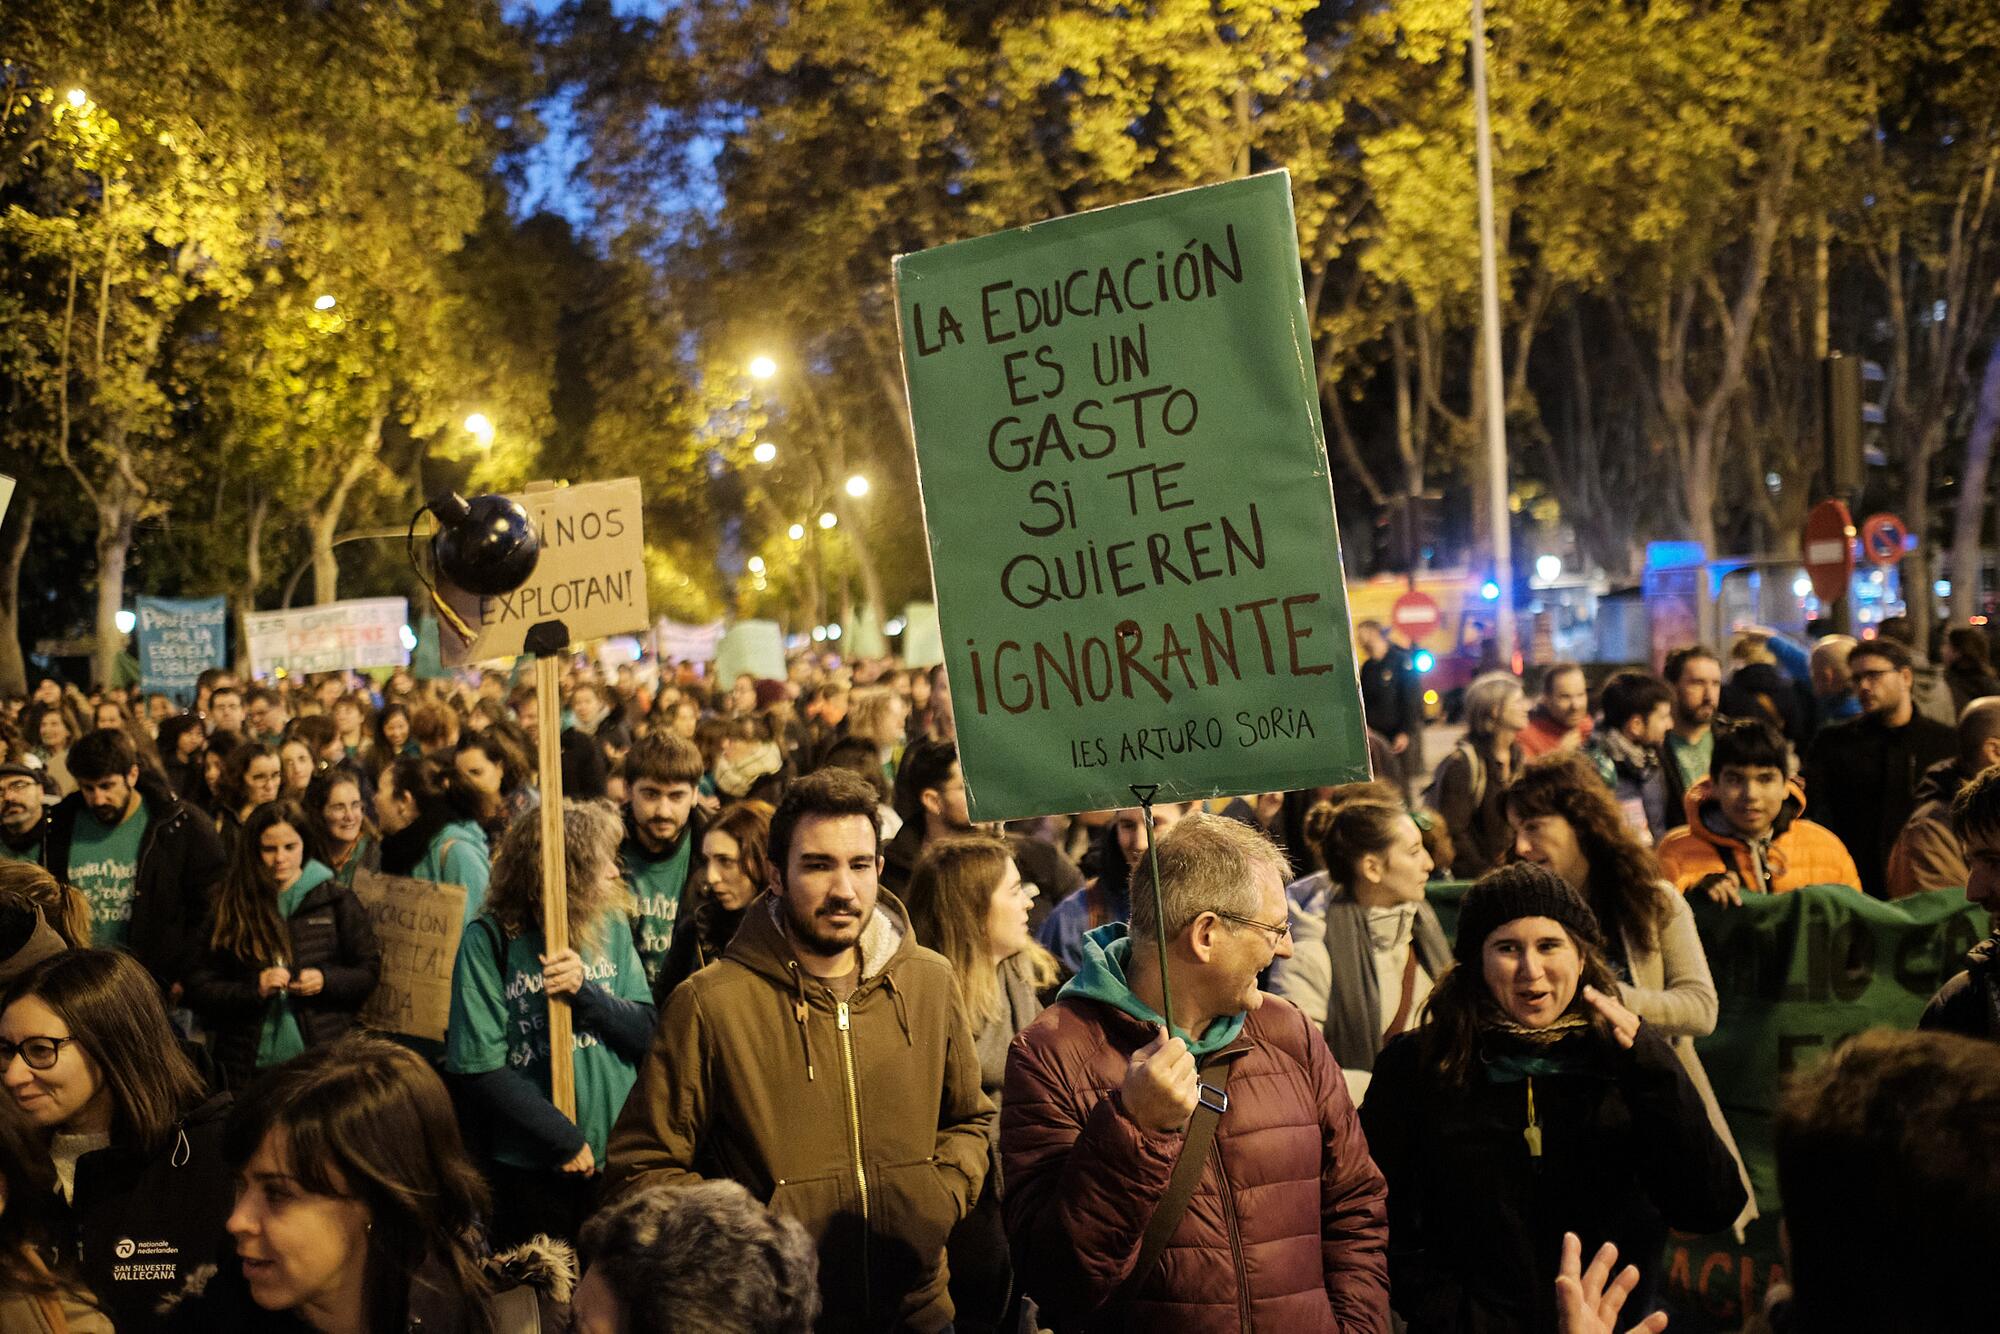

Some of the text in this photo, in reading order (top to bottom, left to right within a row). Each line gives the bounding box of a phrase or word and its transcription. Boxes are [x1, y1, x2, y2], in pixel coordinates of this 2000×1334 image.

[913, 303, 965, 357] LA
[1003, 322, 1150, 406] ES UN
[988, 385, 1198, 472] GASTO
[1107, 462, 1194, 516] TE
[479, 569, 632, 627] EXPLOTAN!
[1120, 717, 1222, 763] ARTURO
[113, 1271, 176, 1281] VALLECANA
[114, 1264, 177, 1273] SAN SILVESTRE
